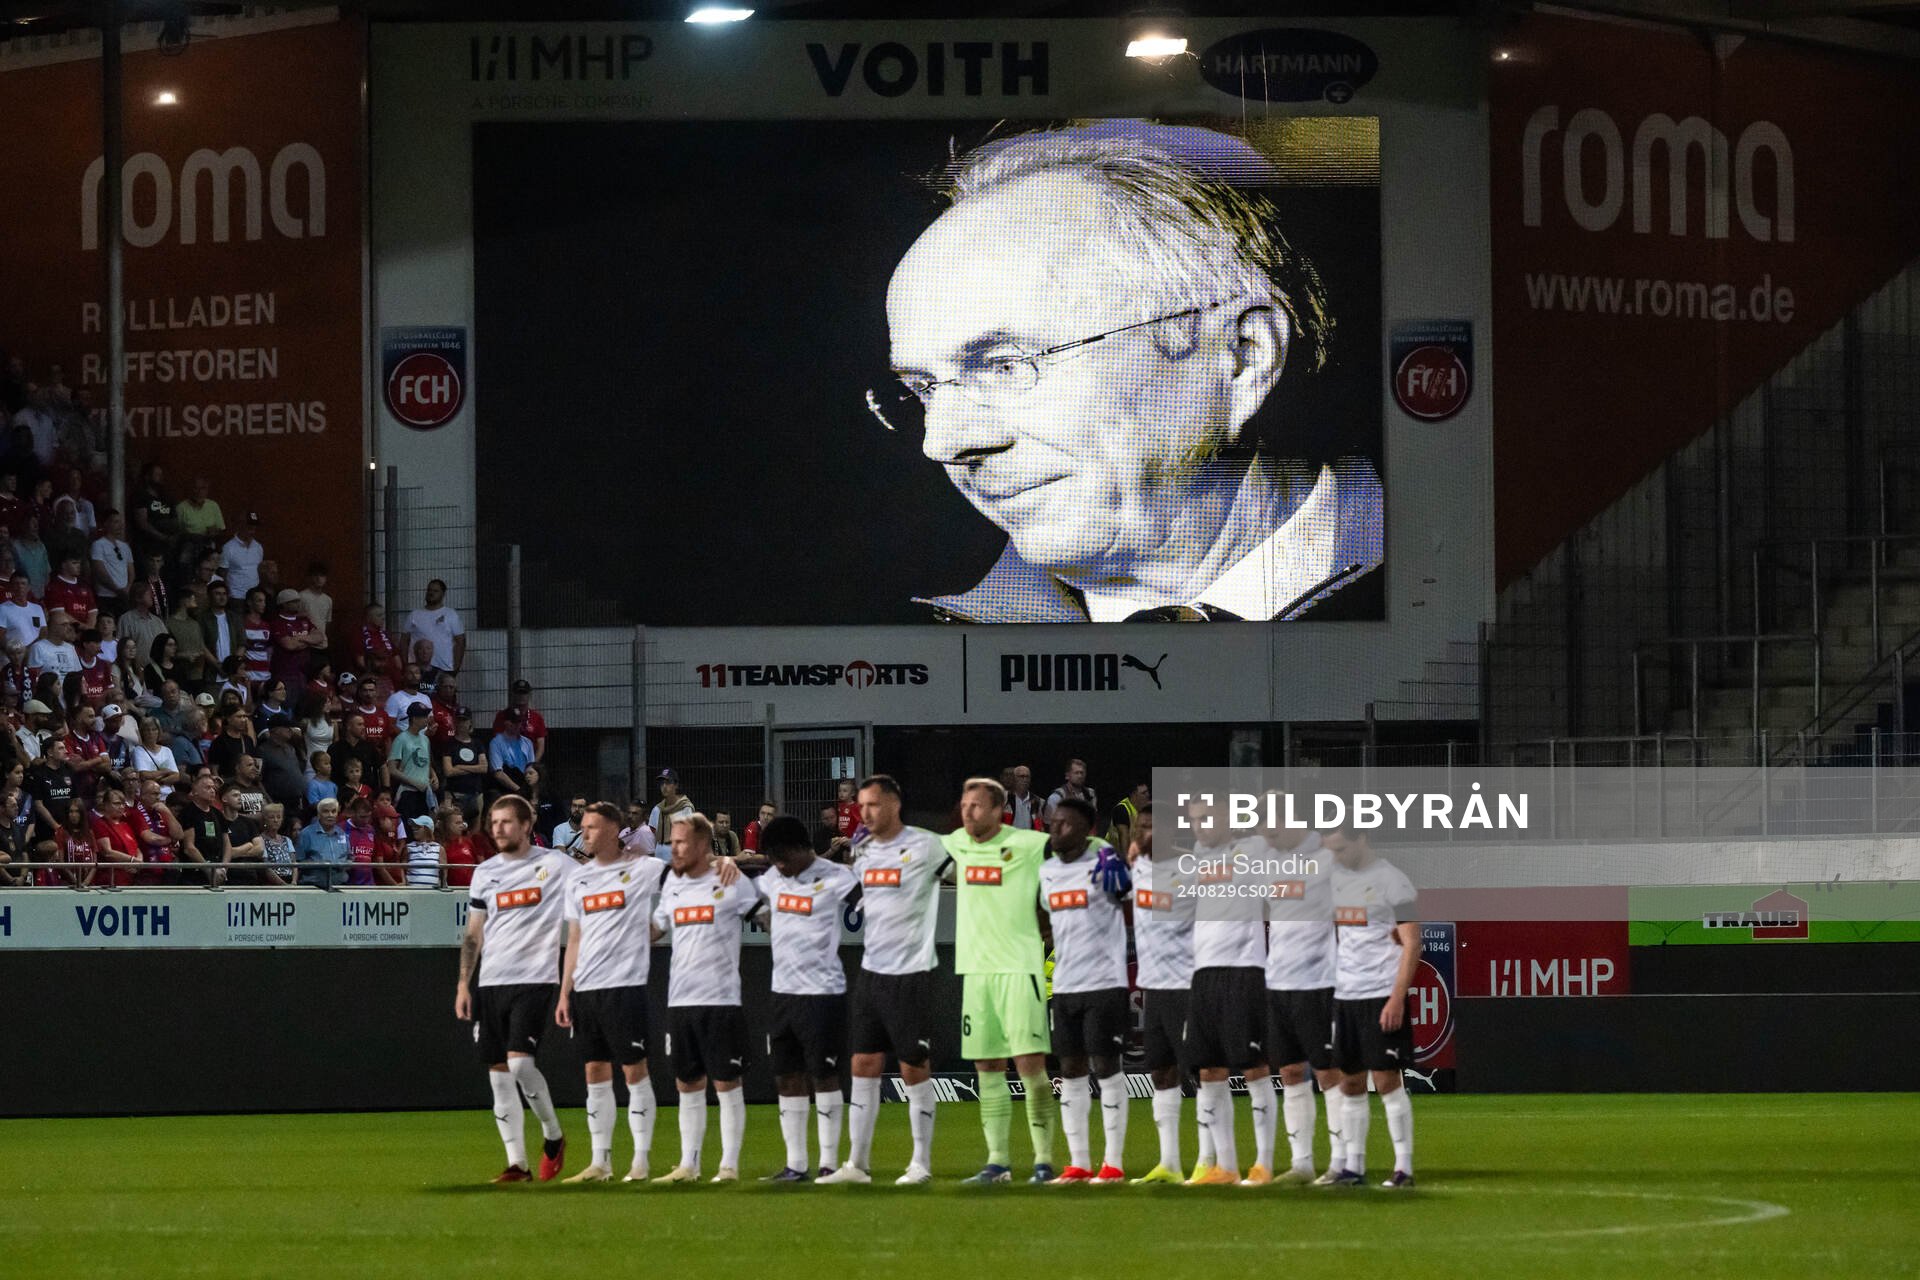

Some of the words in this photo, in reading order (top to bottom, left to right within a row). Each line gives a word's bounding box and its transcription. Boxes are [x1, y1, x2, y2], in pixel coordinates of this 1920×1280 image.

[531, 35, 654, 81] MHP
[807, 42, 1049, 97] VOITH
[1215, 53, 1361, 74] HARTMANN
[1522, 104, 1795, 243] roma
[81, 142, 326, 251] roma
[1523, 272, 1795, 323] www.roma.de
[82, 292, 275, 334] RLLLADEN
[82, 347, 279, 385] RFFSTOREN
[400, 375, 450, 404] FCH
[695, 660, 929, 690] 11TEAMSPORTS
[1001, 654, 1119, 692] PUMA
[499, 890, 540, 906] BRA
[585, 894, 624, 910] BRA
[75, 905, 170, 937] VOITH
[249, 902, 296, 927] MHP
[364, 901, 410, 926] MHP
[676, 907, 713, 921] BRA
[1703, 911, 1798, 928] TRAUB
[234, 934, 264, 943] PORSCHE
[266, 934, 296, 943] COMPANY
[349, 933, 375, 942] PORSCHE
[379, 933, 409, 942] COMPANY
[1428, 942, 1450, 952] 1846
[1531, 958, 1615, 997] MHP
[1407, 986, 1439, 1026] CH
